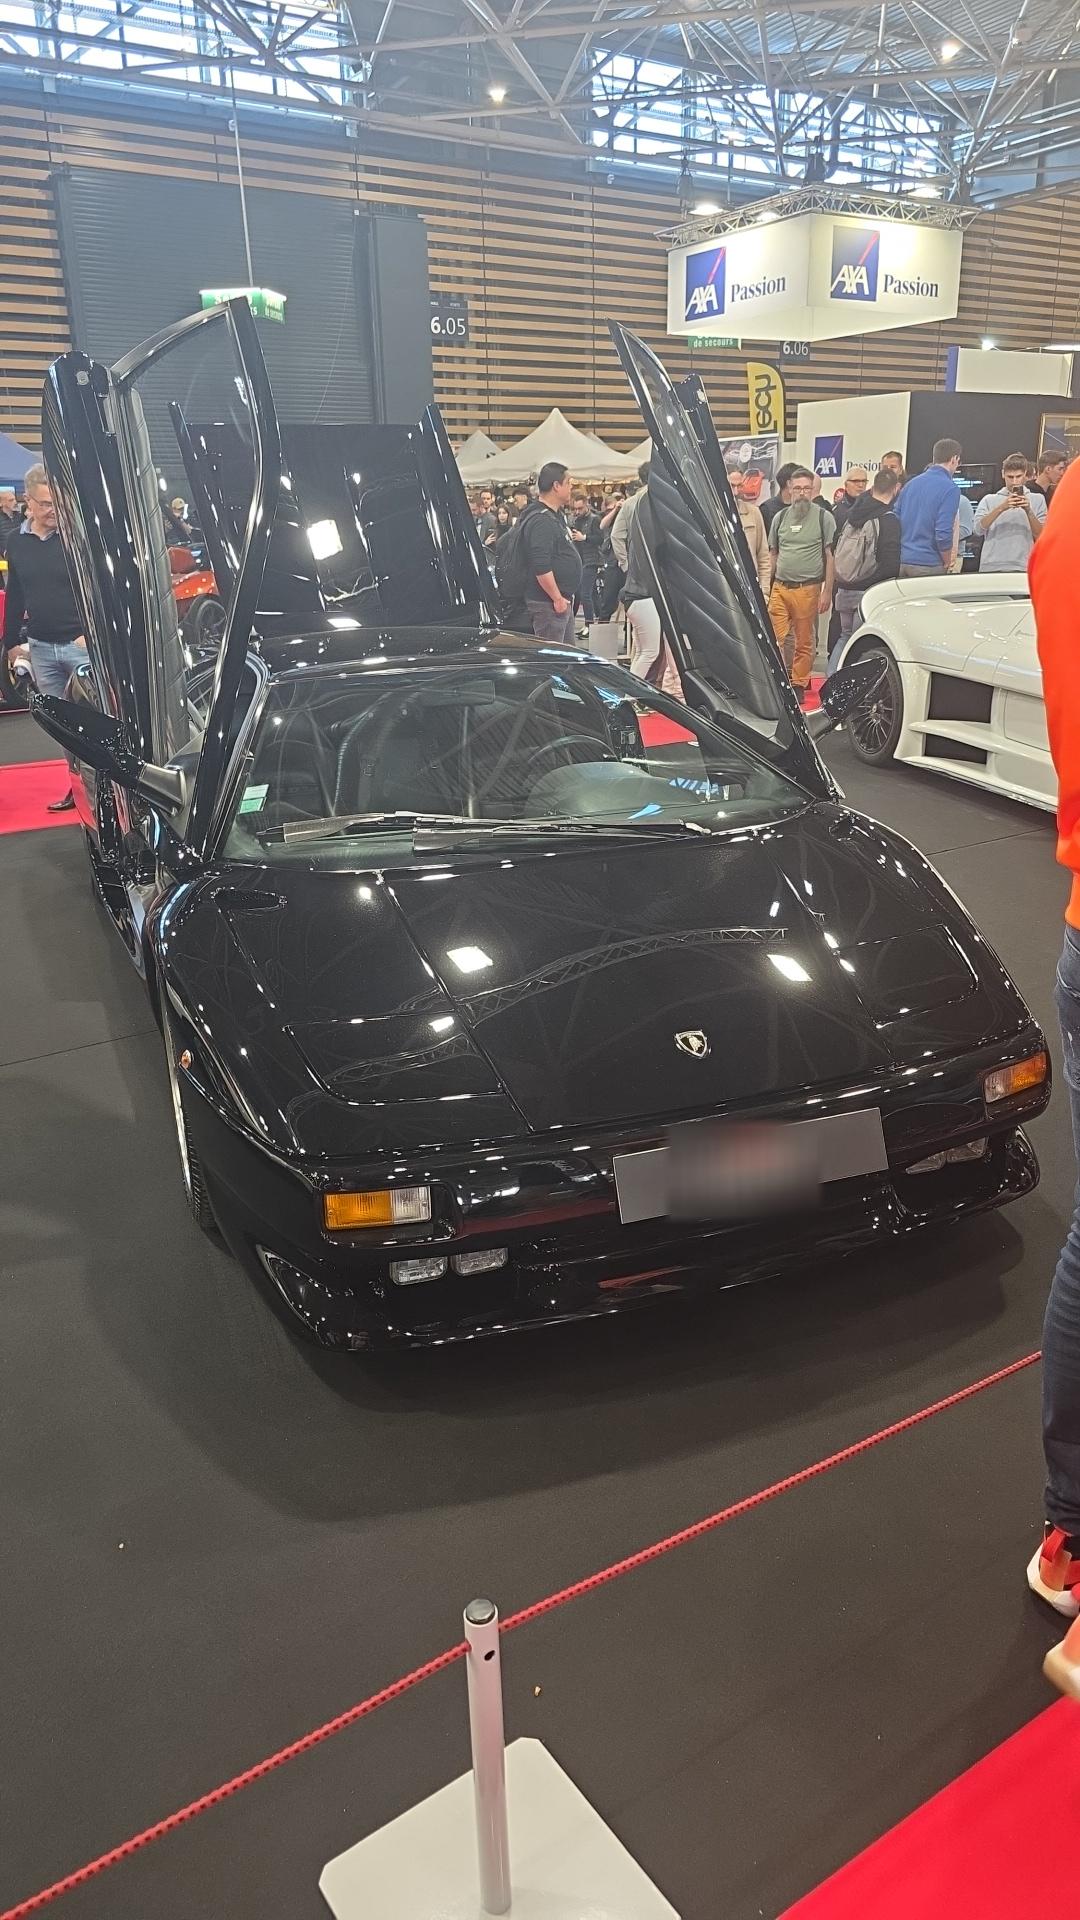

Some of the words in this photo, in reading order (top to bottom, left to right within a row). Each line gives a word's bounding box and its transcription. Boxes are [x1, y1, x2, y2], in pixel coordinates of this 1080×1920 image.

[831, 264, 870, 296] AXA
[883, 273, 940, 299] Passion
[685, 283, 719, 315] AXA
[730, 275, 787, 303] Passion
[430, 316, 466, 336] 6.05
[693, 338, 703, 348] de
[704, 338, 734, 348] secours
[782, 340, 809, 356] 6.06
[815, 456, 838, 475] AXA
